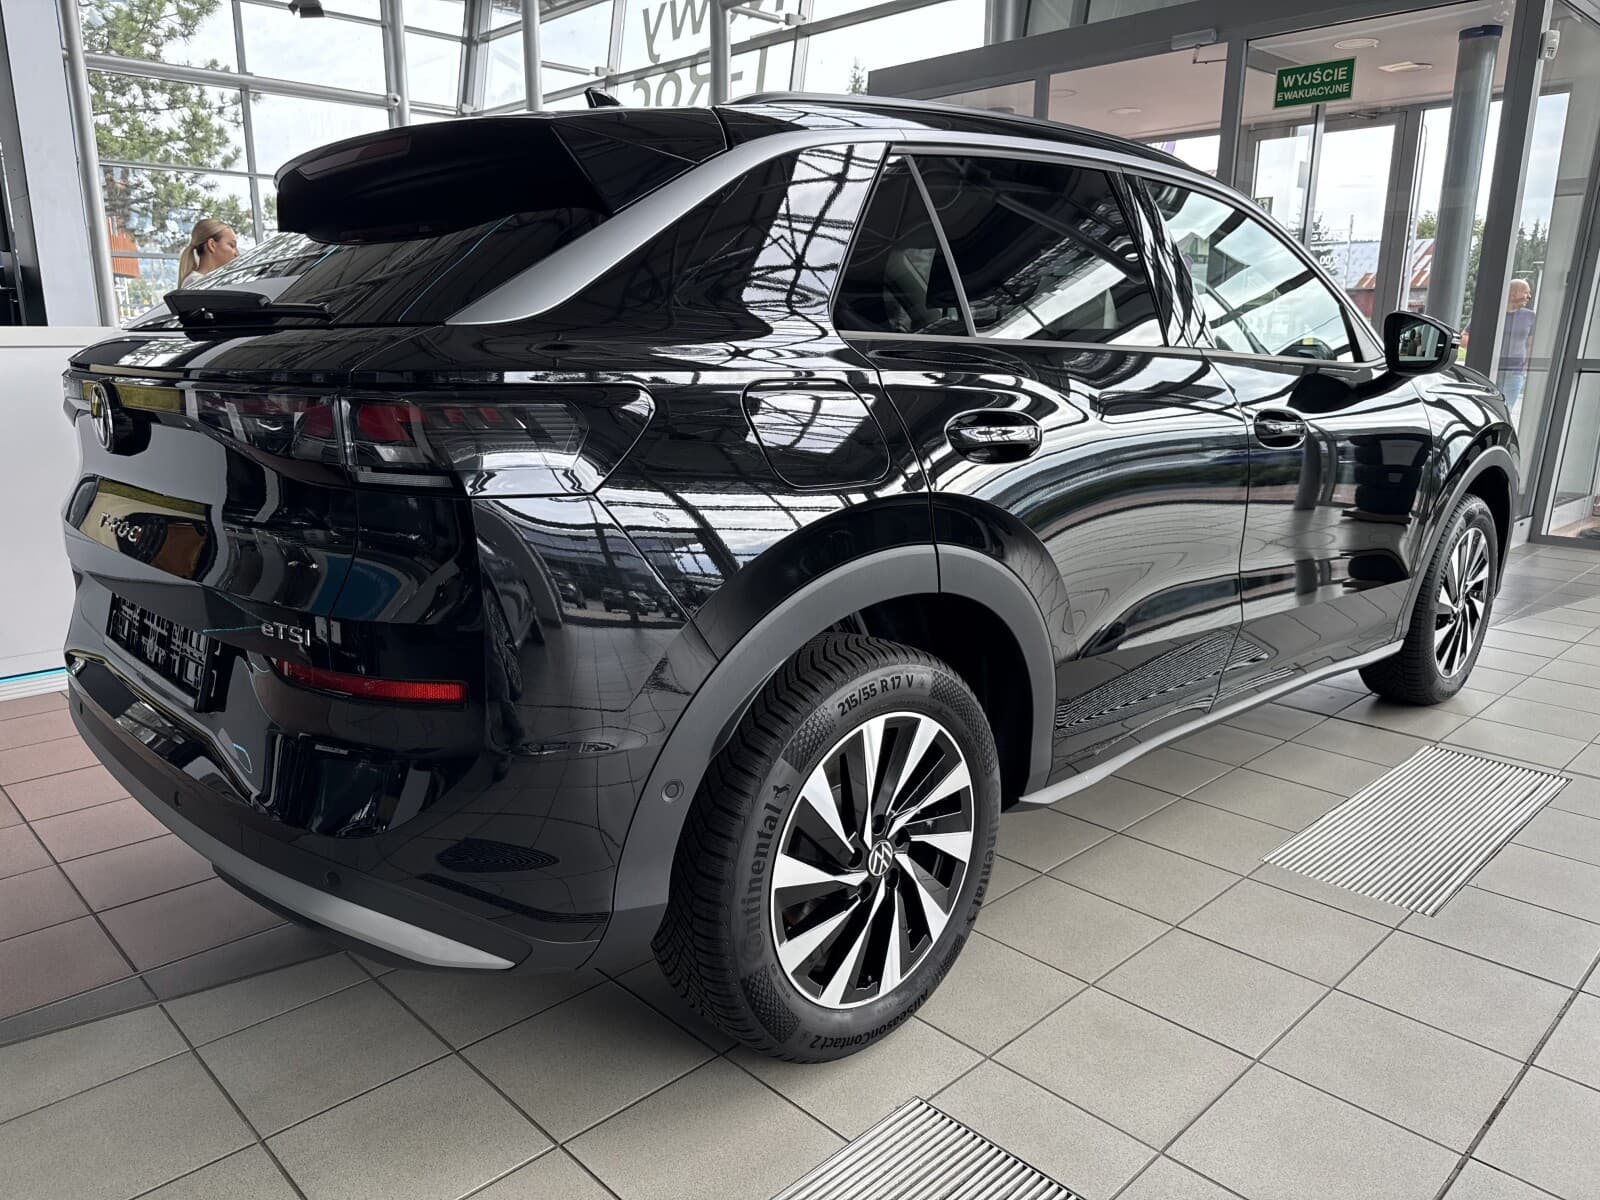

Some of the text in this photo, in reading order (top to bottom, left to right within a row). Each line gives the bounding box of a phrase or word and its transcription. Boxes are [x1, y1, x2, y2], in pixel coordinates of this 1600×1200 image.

[1282, 67, 1348, 88] WYJŚCIE
[1277, 82, 1350, 101] EWAKUACYJNE
[261, 621, 311, 647] eTSI
[837, 674, 914, 716] 215/55 R 17 V
[809, 1034, 822, 1049] 2
